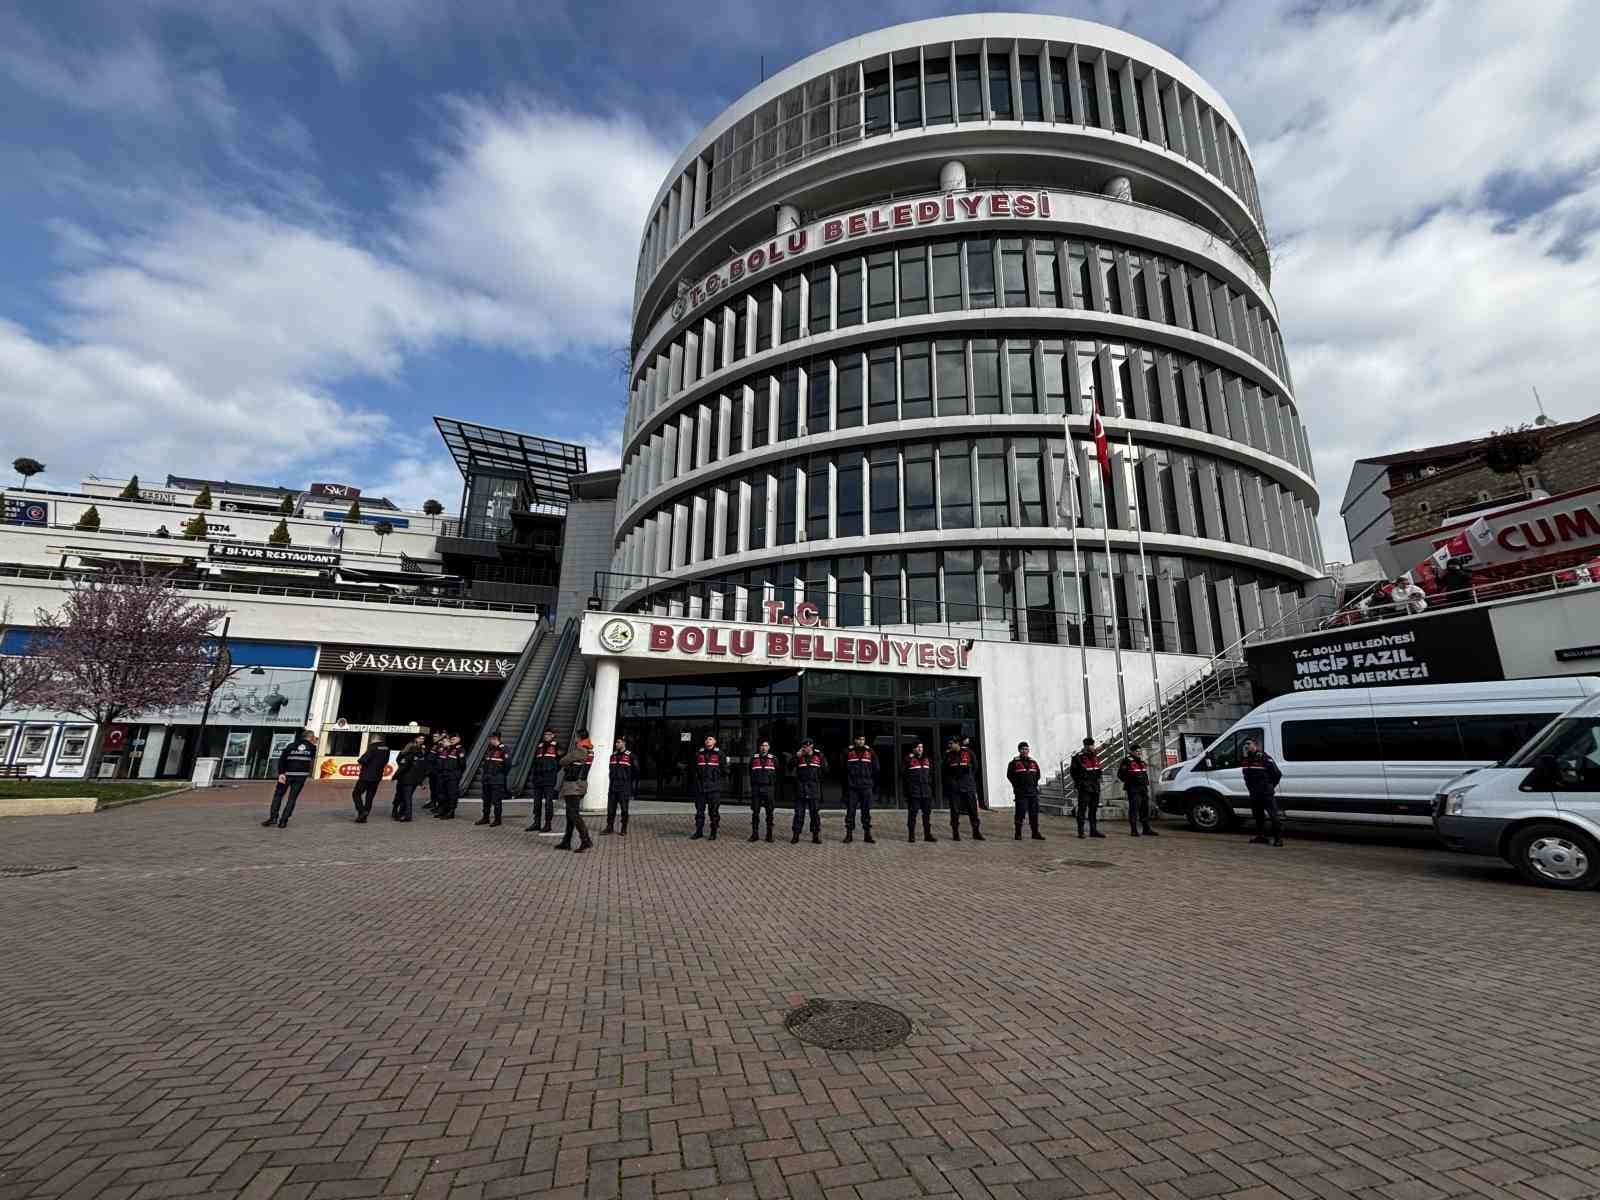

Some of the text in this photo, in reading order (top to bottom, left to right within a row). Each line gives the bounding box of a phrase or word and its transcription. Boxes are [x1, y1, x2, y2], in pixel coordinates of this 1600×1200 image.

[729, 229, 808, 283] BOLU
[823, 190, 1052, 244] BELEDİYESİ
[1497, 504, 1600, 552] CUM
[266, 551, 336, 563] RESTAURANT
[763, 600, 828, 628] T.C.
[649, 624, 969, 669] BOLU BELEDİYESİ
[1292, 631, 1416, 659] T.C. BOLU BELEDİYESİ
[431, 656, 490, 676] ÇARŞI
[1293, 662, 1429, 690] KÜLTÜR MERKEZİ
[1296, 649, 1414, 675] NECİP FAZIL
